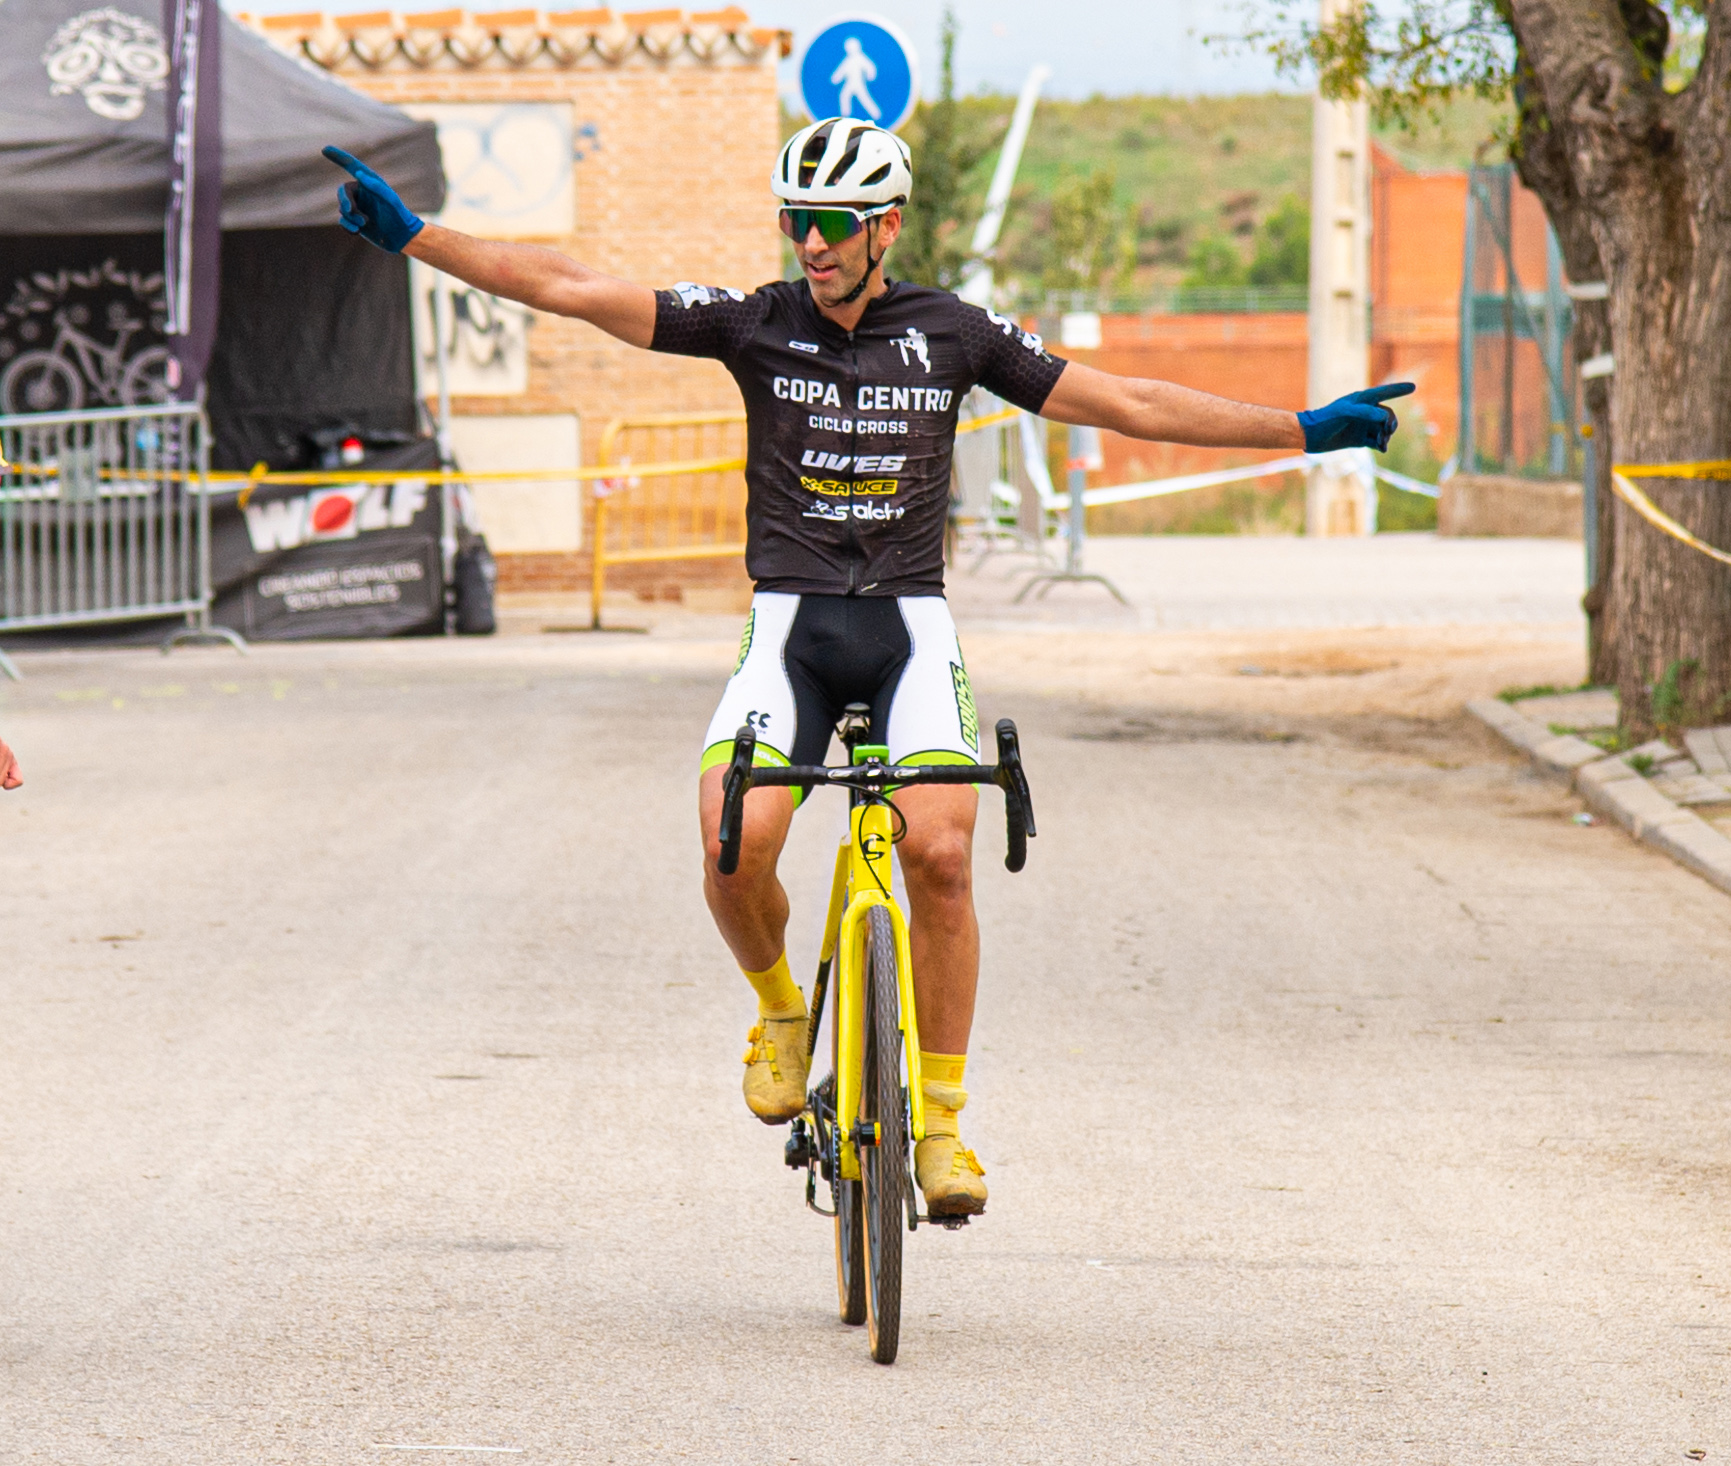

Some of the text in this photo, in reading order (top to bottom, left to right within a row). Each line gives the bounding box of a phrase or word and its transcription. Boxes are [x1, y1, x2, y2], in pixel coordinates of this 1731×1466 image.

[773, 376, 953, 412] COPA CENTRO
[800, 476, 898, 496] X-SAUCE
[246, 480, 427, 553] WOLF
